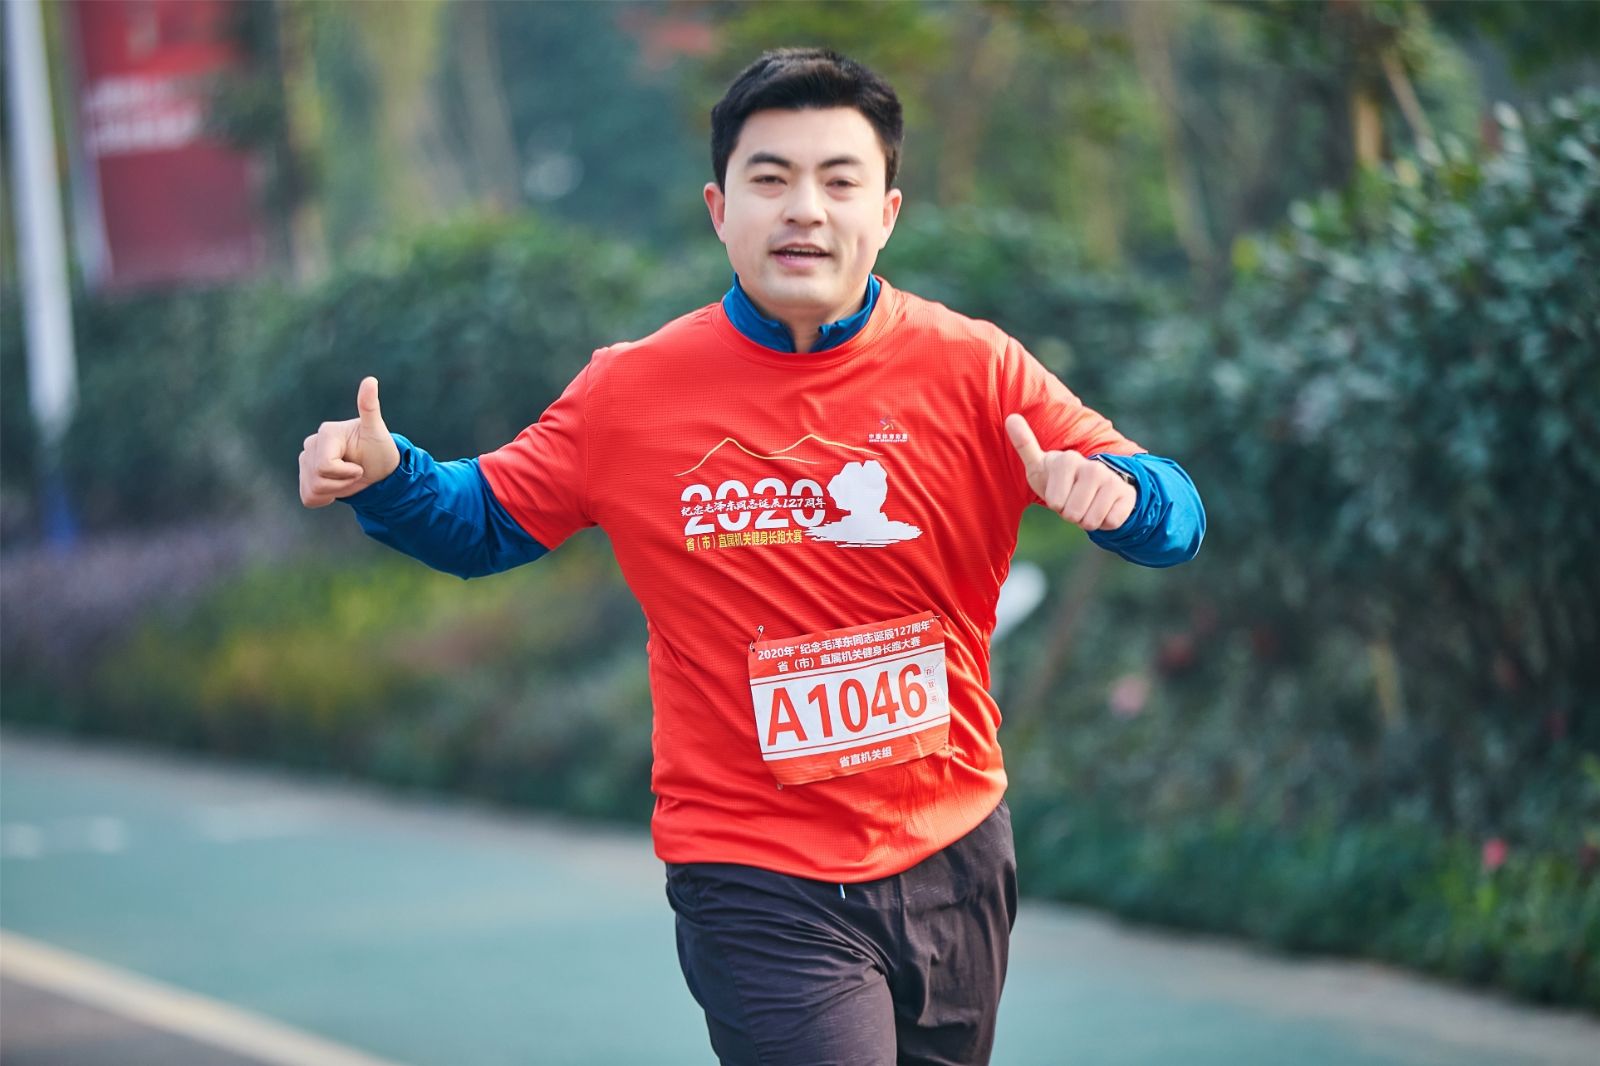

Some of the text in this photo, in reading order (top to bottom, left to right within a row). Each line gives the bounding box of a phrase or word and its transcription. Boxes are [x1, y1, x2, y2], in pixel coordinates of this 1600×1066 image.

[681, 477, 825, 536] 2020
[681, 496, 826, 517] 纪念毛泽东同志诞辰127周年
[767, 663, 928, 747] A1046
[839, 746, 893, 768] 省直机关组
